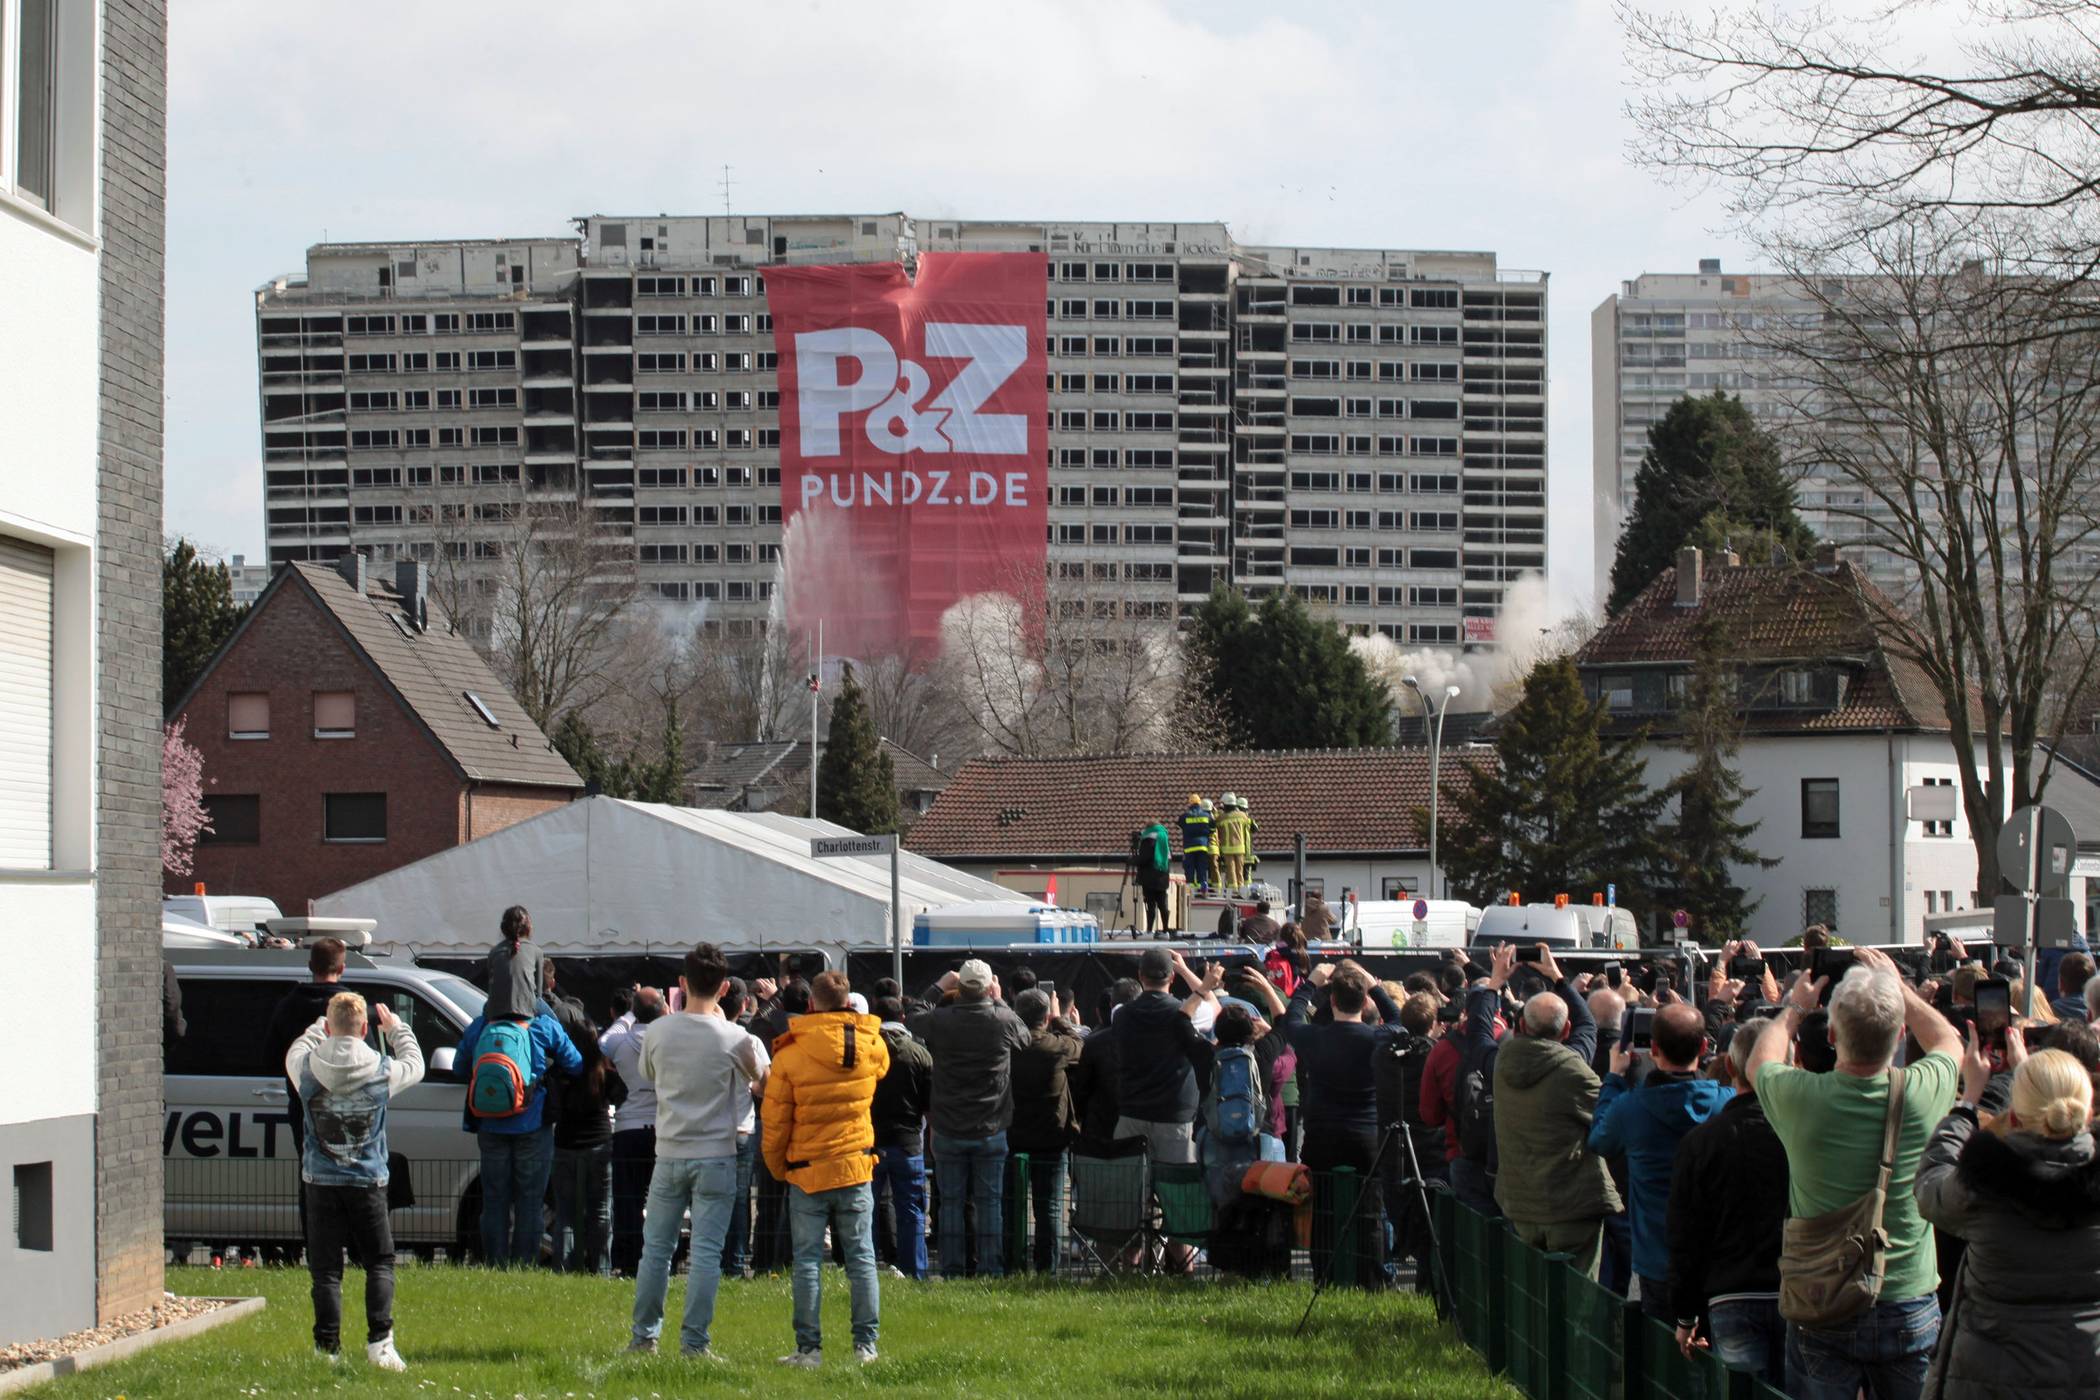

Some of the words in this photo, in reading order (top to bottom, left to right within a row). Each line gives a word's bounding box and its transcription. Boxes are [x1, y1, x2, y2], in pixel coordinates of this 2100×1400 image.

[795, 322, 1028, 457] P&Z
[801, 471, 1028, 508] PUNDZ.DE
[817, 840, 884, 853] Charlottenstr.
